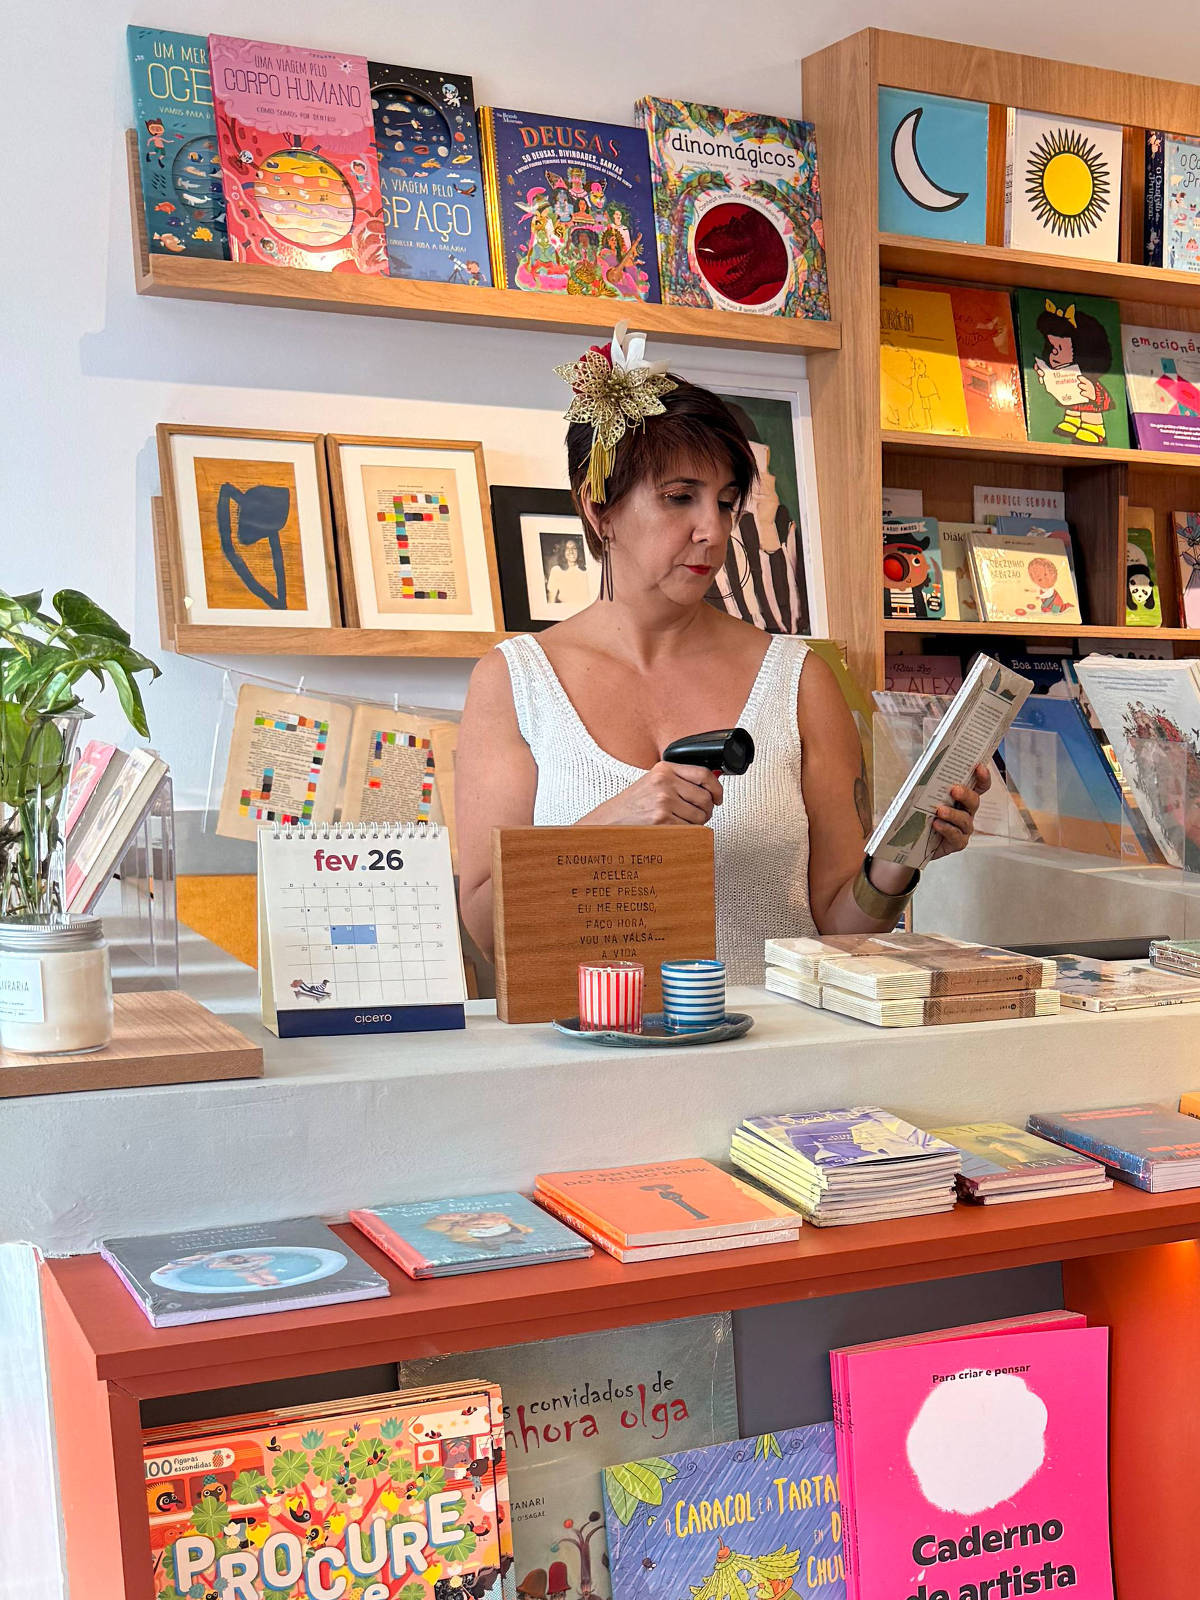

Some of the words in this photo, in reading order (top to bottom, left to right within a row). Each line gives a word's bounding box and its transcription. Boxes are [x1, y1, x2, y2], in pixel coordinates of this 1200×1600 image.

[153, 40, 175, 60] UM
[254, 54, 273, 71] UMA
[276, 58, 307, 76] VIAGEM
[309, 62, 328, 79] PELO
[147, 62, 214, 106] OCE
[223, 67, 281, 97] CORPO
[286, 76, 362, 108] HUMANO
[519, 125, 620, 159] DEUSAS
[671, 132, 796, 169] dinomágicos
[600, 158, 624, 176] SANTAS
[1180, 154, 1188, 167] O
[391, 179, 429, 196] VIAGEM
[432, 183, 454, 198] PELO
[1011, 659, 1032, 670] Boa
[314, 849, 404, 872] fev.26
[557, 854, 613, 866] ENQUANTO
[618, 855, 625, 865] O
[631, 854, 663, 865] TEMPO
[593, 870, 639, 881] ACELERA
[571, 888, 578, 898] E
[585, 887, 612, 897] PEDE
[578, 903, 592, 914] EU
[597, 902, 611, 912] ME
[580, 935, 599, 945] VOU
[604, 933, 618, 944] NA
[602, 950, 607, 959] A
[613, 948, 637, 958] VIDA
[354, 1013, 392, 1024] cicero
[932, 1372, 957, 1384] Para
[958, 1369, 984, 1381] criar
[985, 1369, 992, 1377] e
[994, 1364, 1032, 1376] pensar
[529, 1378, 635, 1415] convidados
[652, 1370, 675, 1394] de
[504, 1404, 600, 1454] nhora
[619, 1384, 690, 1441] olga
[173, 1455, 200, 1467] figuras
[174, 1459, 212, 1474] escondidas
[675, 1491, 756, 1538] CARACOL
[765, 1497, 773, 1512] A
[173, 1489, 468, 1600] PROCURE
[911, 1517, 1065, 1568] Caderno
[957, 1560, 1078, 1600] artista
